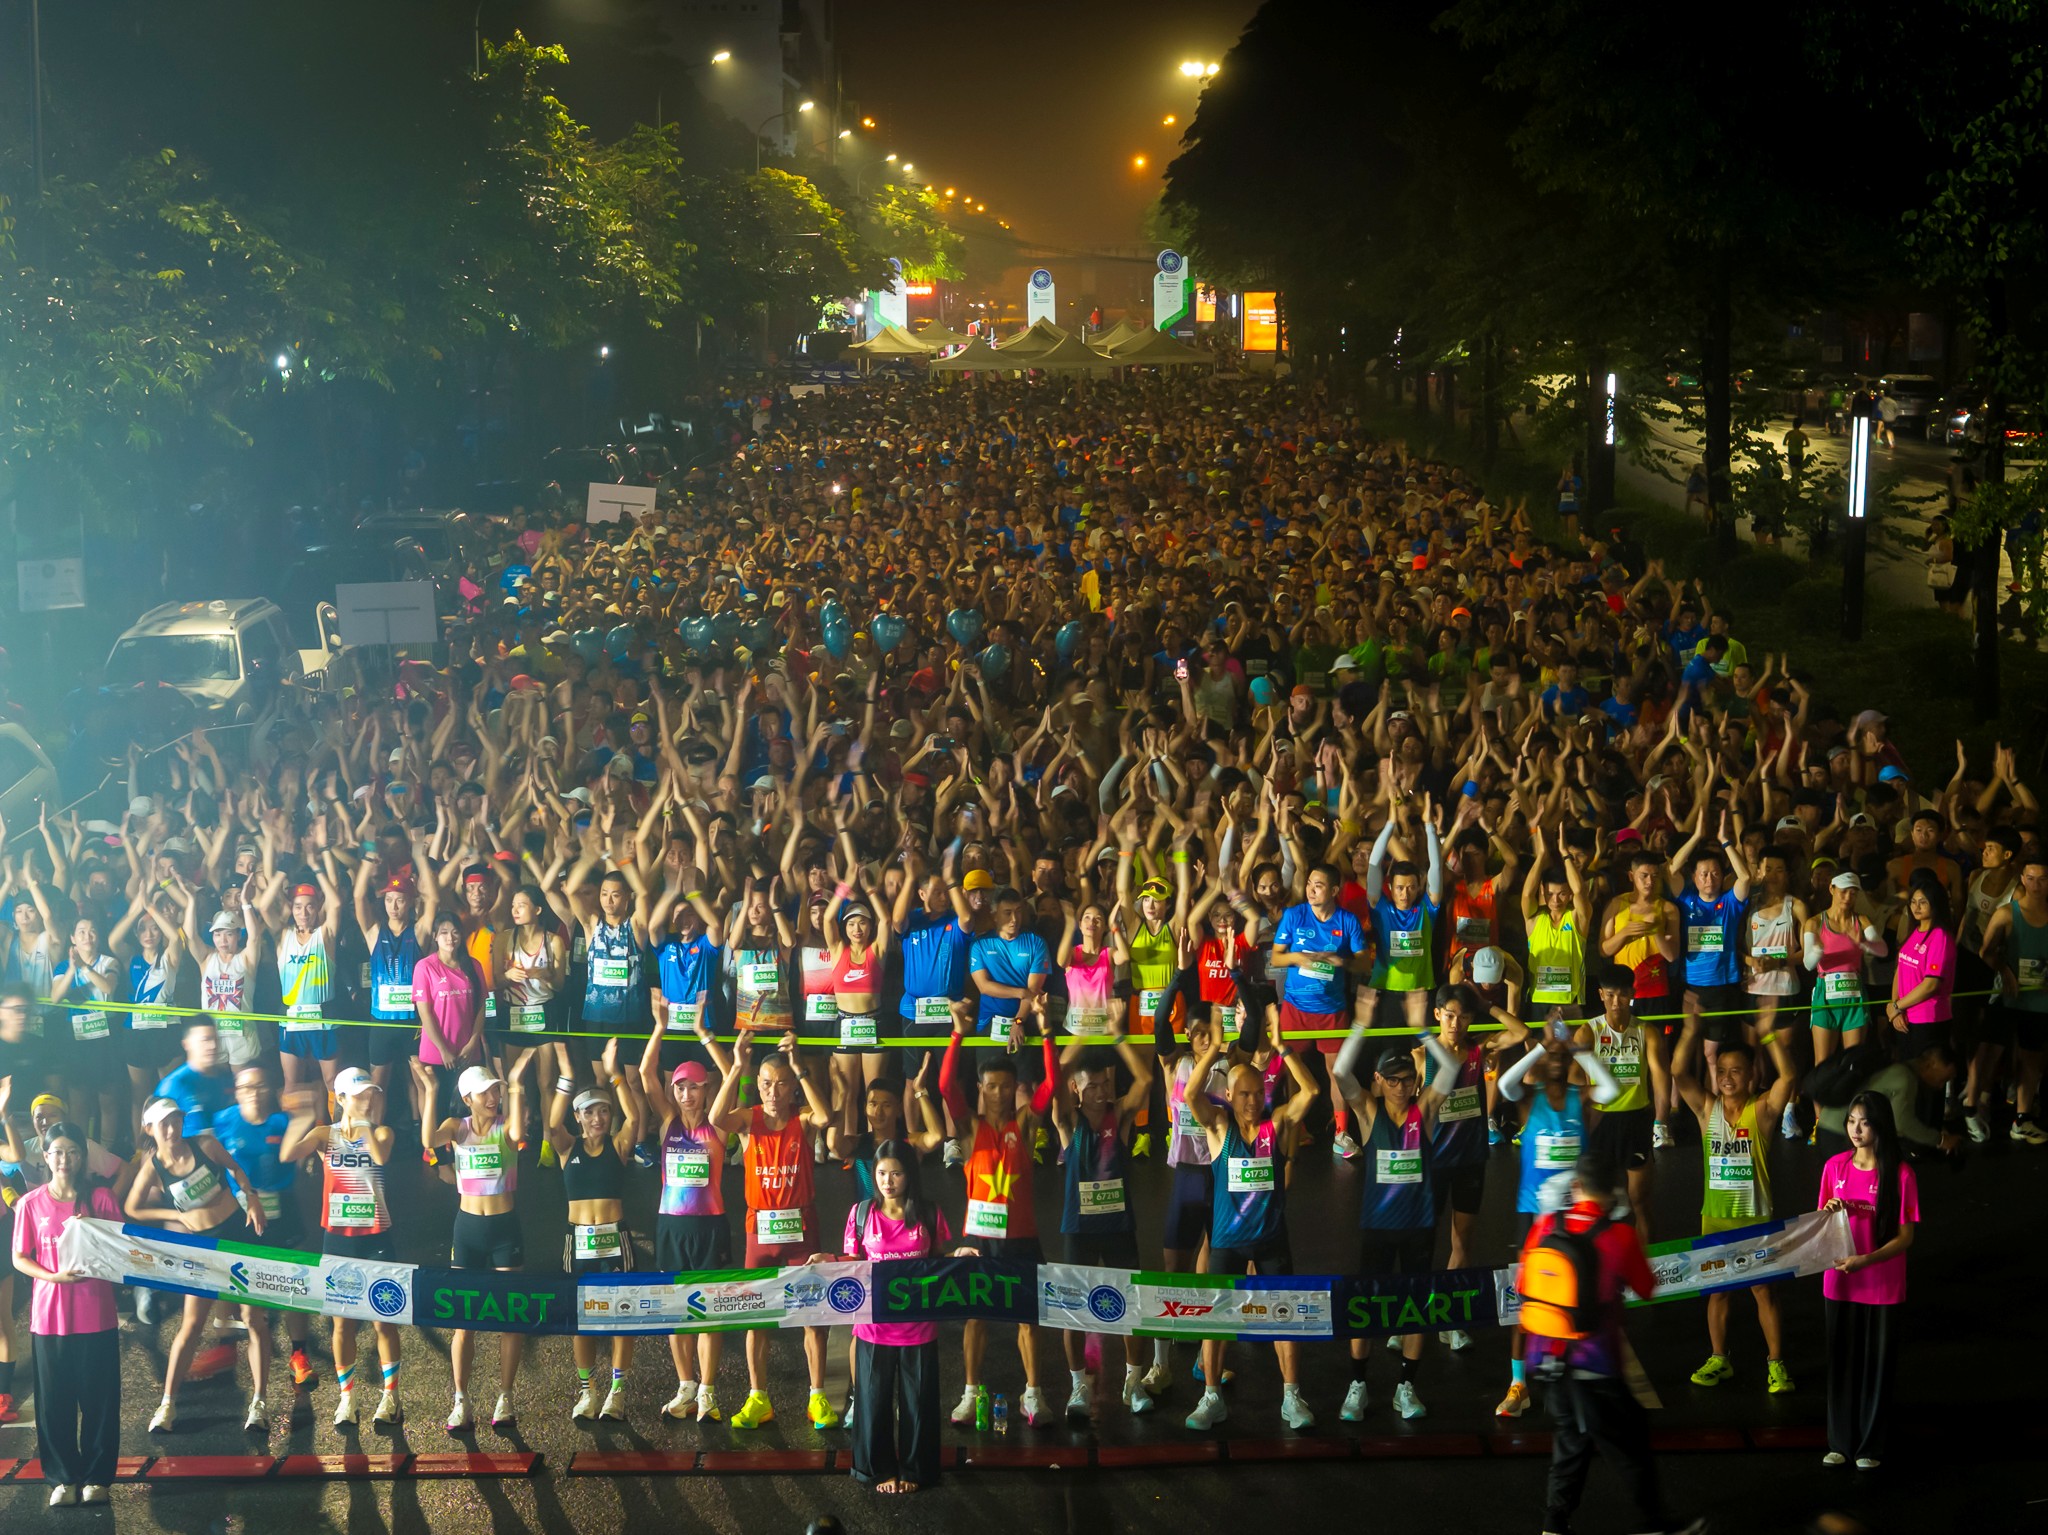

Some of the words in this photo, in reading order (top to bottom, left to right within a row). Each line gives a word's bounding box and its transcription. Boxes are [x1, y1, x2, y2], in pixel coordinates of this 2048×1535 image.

[1700, 935, 1722, 943] 62704
[604, 967, 625, 976] 68241
[755, 971, 776, 979] 63865
[1209, 969, 1233, 978] RU
[214, 978, 234, 987] ELITE
[1548, 974, 1569, 982] 69895
[1837, 982, 1857, 991] 65507
[928, 1003, 949, 1012] 63769
[522, 1014, 542, 1022] 67276
[679, 1012, 696, 1020] 6336
[854, 1029, 875, 1038] 68002
[1600, 1045, 1640, 1054] ANTA
[1613, 1065, 1637, 1074] 65562
[1454, 1098, 1476, 1108] 65533
[1712, 1140, 1721, 1153] PR
[1723, 1140, 1752, 1154] SPORT
[331, 1154, 372, 1167] USA
[680, 1165, 704, 1174] 67174
[755, 1166, 776, 1175] BAC
[777, 1165, 801, 1174] NINH
[1245, 1169, 1268, 1177] 61738
[1724, 1166, 1751, 1176] 69406
[762, 1176, 793, 1189] RUN
[1096, 1193, 1120, 1203] 67218
[346, 1205, 372, 1214] 65564
[773, 1221, 800, 1230] 63424
[590, 1236, 615, 1246] 67451
[256, 1272, 305, 1286] standard
[256, 1281, 308, 1296] chartered
[888, 1272, 1021, 1311] START
[714, 1291, 763, 1304] standard
[434, 1288, 556, 1324] START
[714, 1299, 766, 1312] chartered
[1154, 1301, 1214, 1317] XTEP
[1347, 1288, 1478, 1329] START
